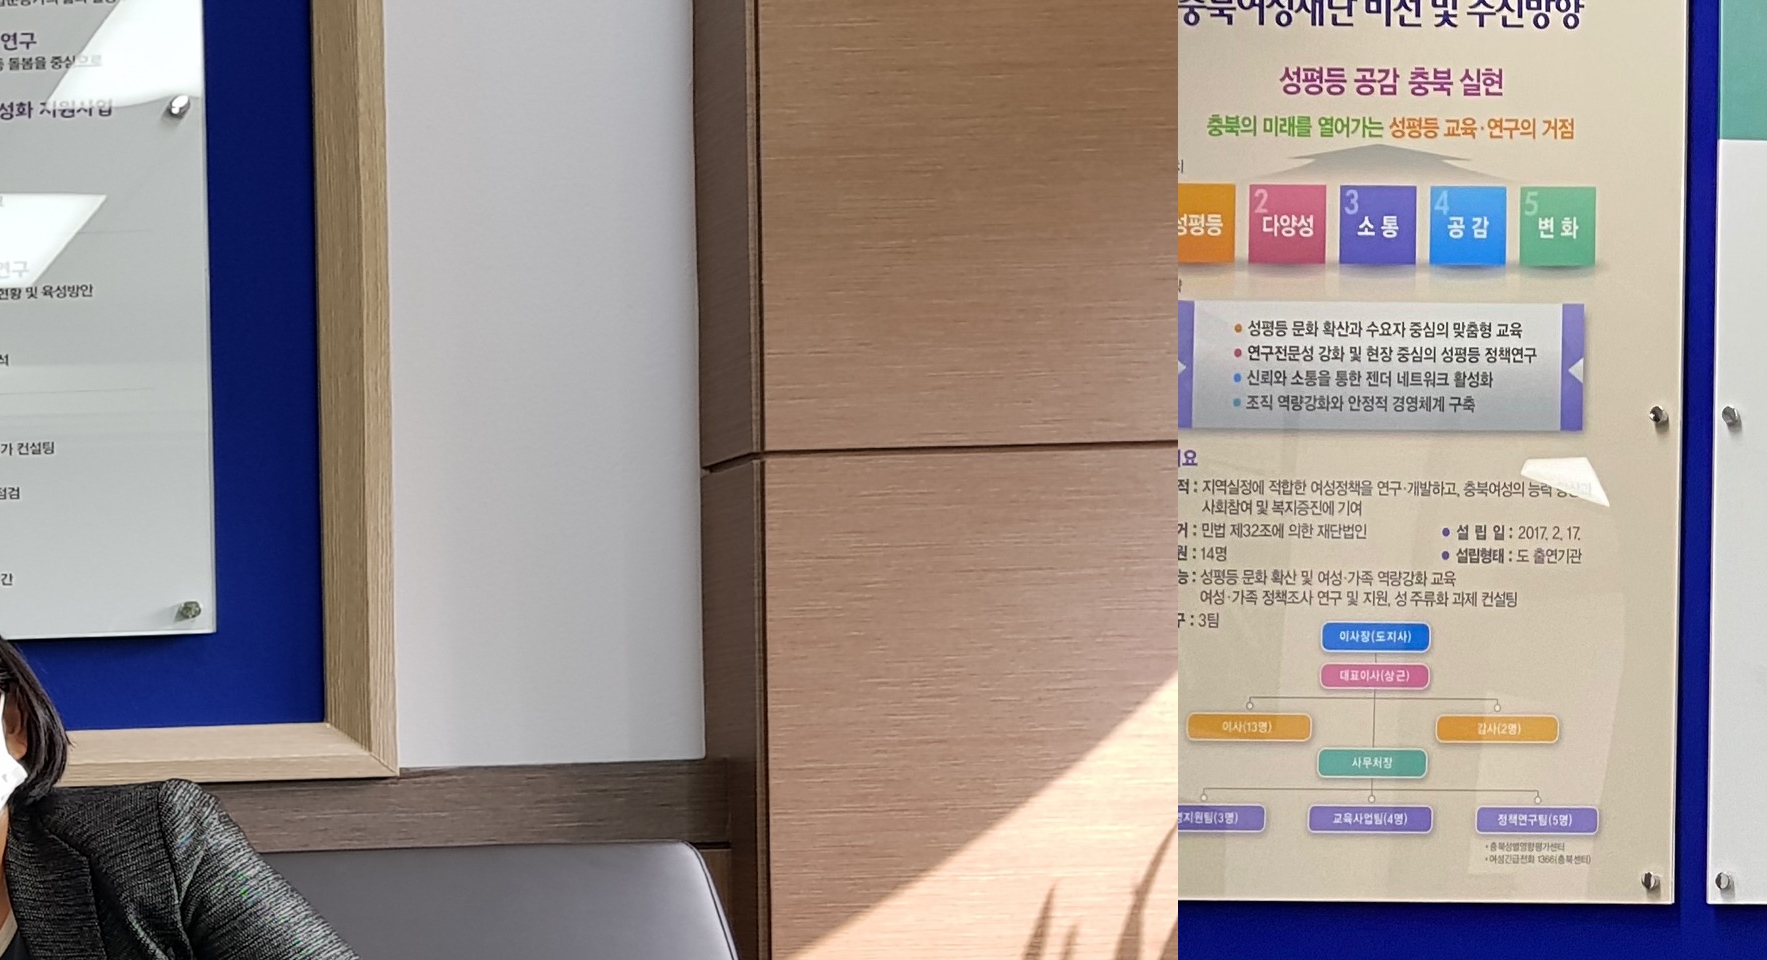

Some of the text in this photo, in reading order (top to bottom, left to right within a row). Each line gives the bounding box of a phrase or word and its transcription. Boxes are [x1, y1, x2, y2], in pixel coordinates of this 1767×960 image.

[1279, 66, 1503, 97] 성평등 공감 충북 실현
[1206, 113, 1575, 140] 충북의 미래를 열어가는 성평등 교육·연구의 거점
[1262, 214, 1314, 238] 다양성
[1247, 319, 1523, 339] 성평등 문화 확산과 수요자 중심의 맞춤형 교육
[1246, 369, 1494, 389] 신뢰와 소통을 통한 젠더 네트워크 활성화
[1201, 498, 1362, 517] 사회참여 및 복지증진에 기여
[1338, 627, 1414, 644] 이사장(도지사)
[1339, 669, 1410, 683] 대표이사(상근)
[1222, 721, 1273, 734] 이사(13명)
[1476, 721, 1523, 737] 감사(2명)
[1351, 756, 1393, 770] 사무처장
[1332, 812, 1408, 826] 교육사업팀(4명)
[1497, 813, 1573, 827] 정책연구팀(5명)
